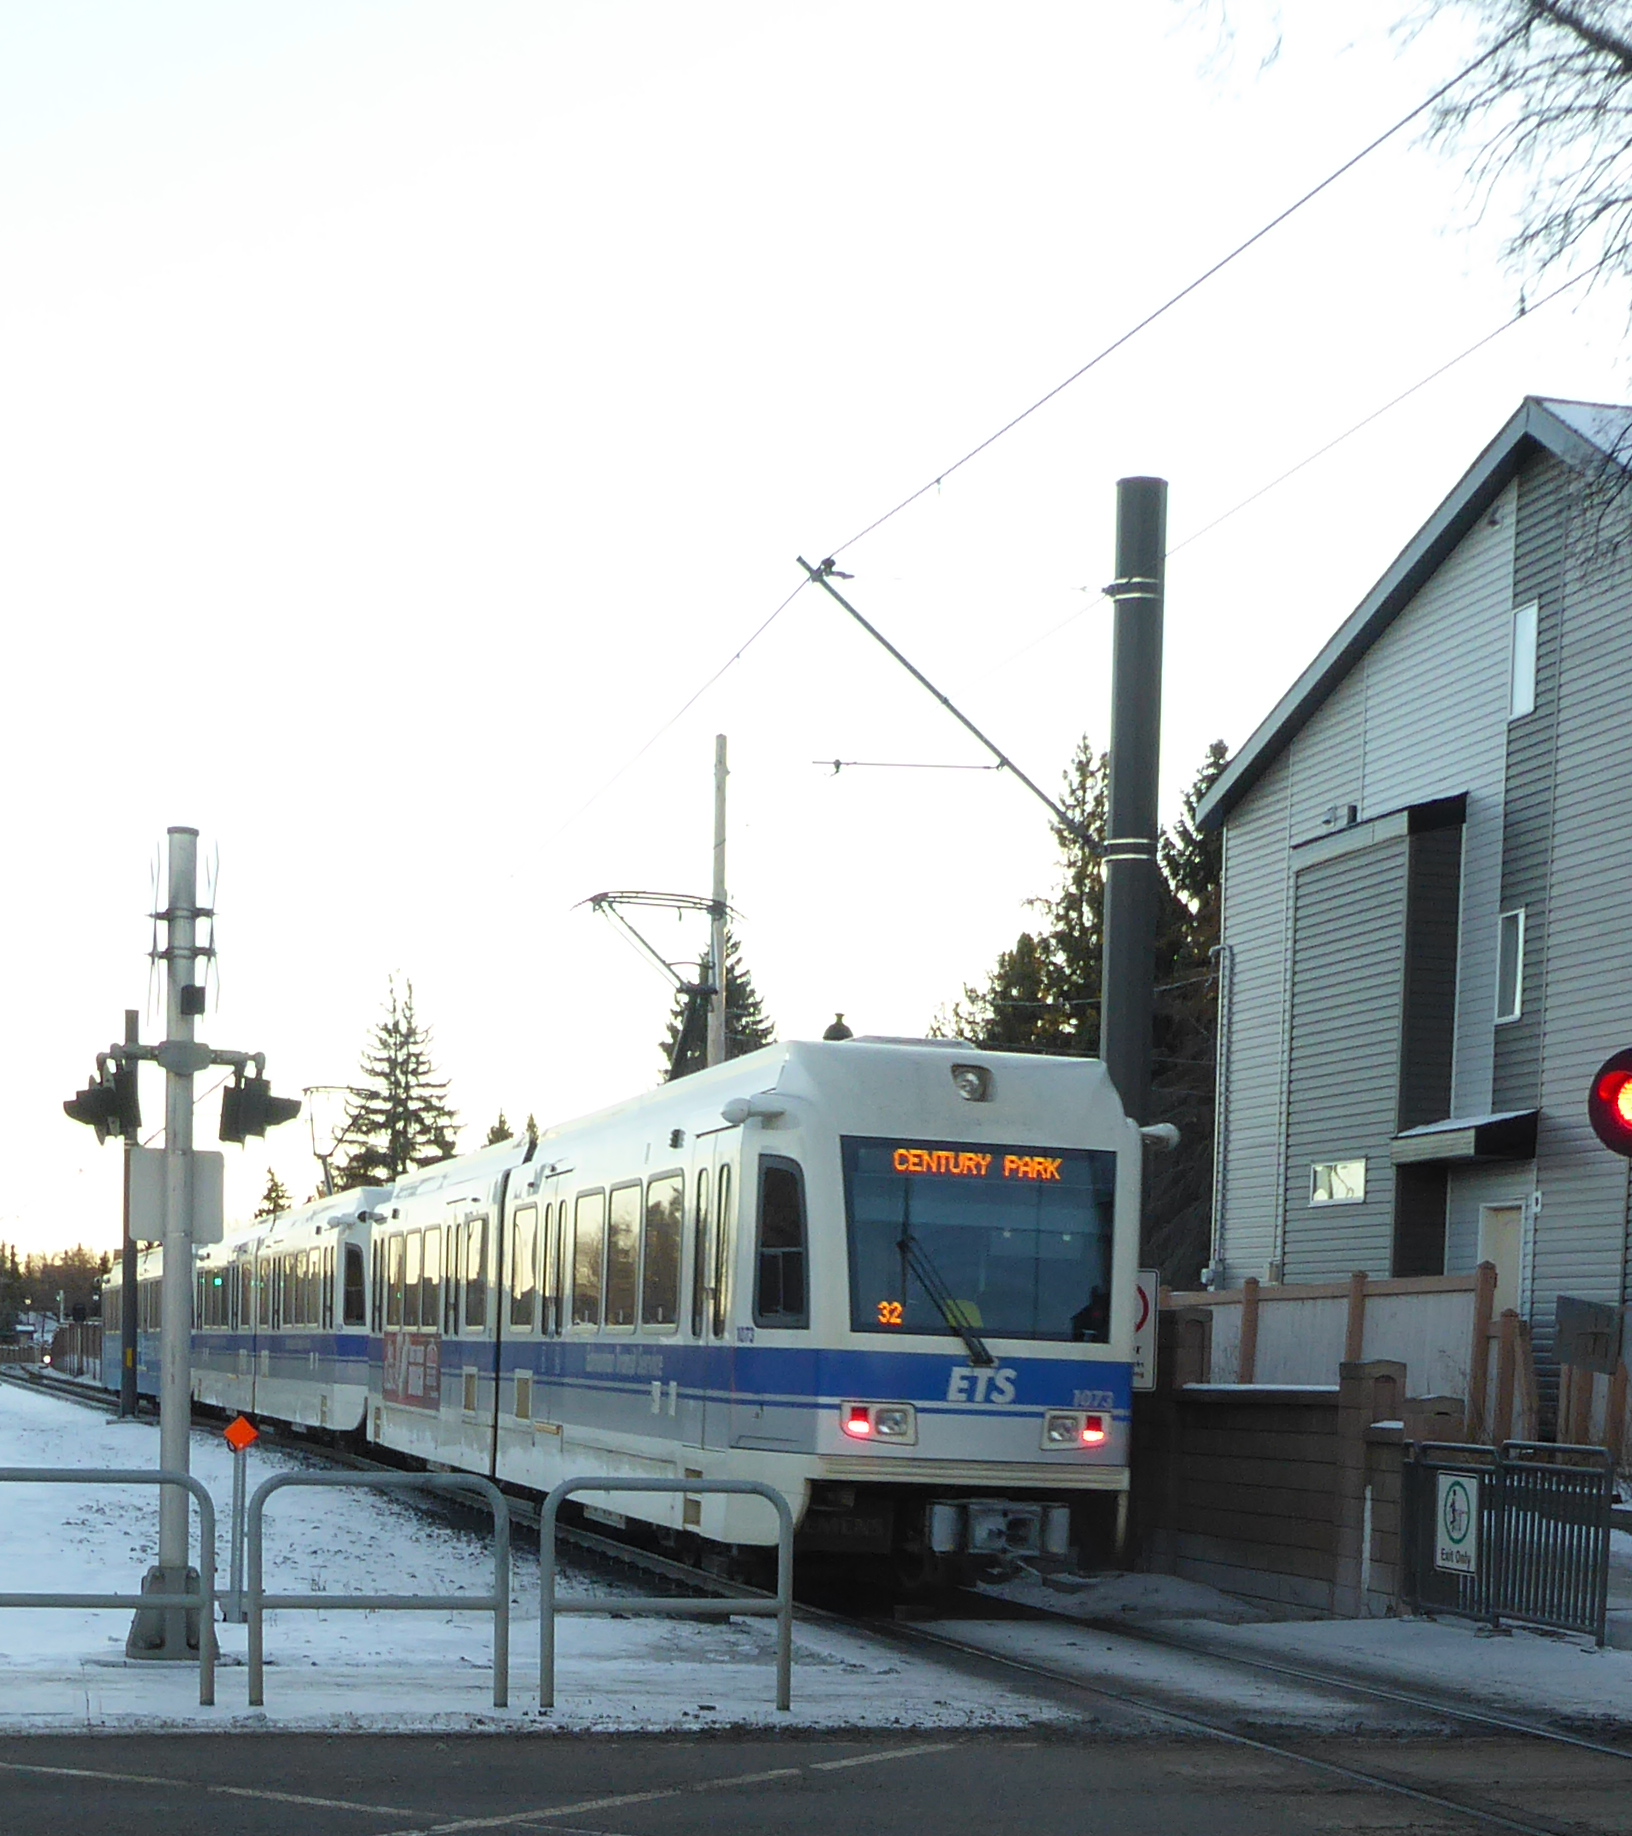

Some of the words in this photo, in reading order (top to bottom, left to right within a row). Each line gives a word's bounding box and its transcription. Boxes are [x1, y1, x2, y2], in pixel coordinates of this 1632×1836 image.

[894, 1149, 992, 1176] CENTURY
[1003, 1155, 1063, 1180] PARK
[877, 1301, 903, 1325] 32
[947, 1366, 1018, 1404] ETS
[1073, 1389, 1115, 1408] 1073
[1440, 1547, 1454, 1563] Exit
[1455, 1549, 1472, 1572] Only
